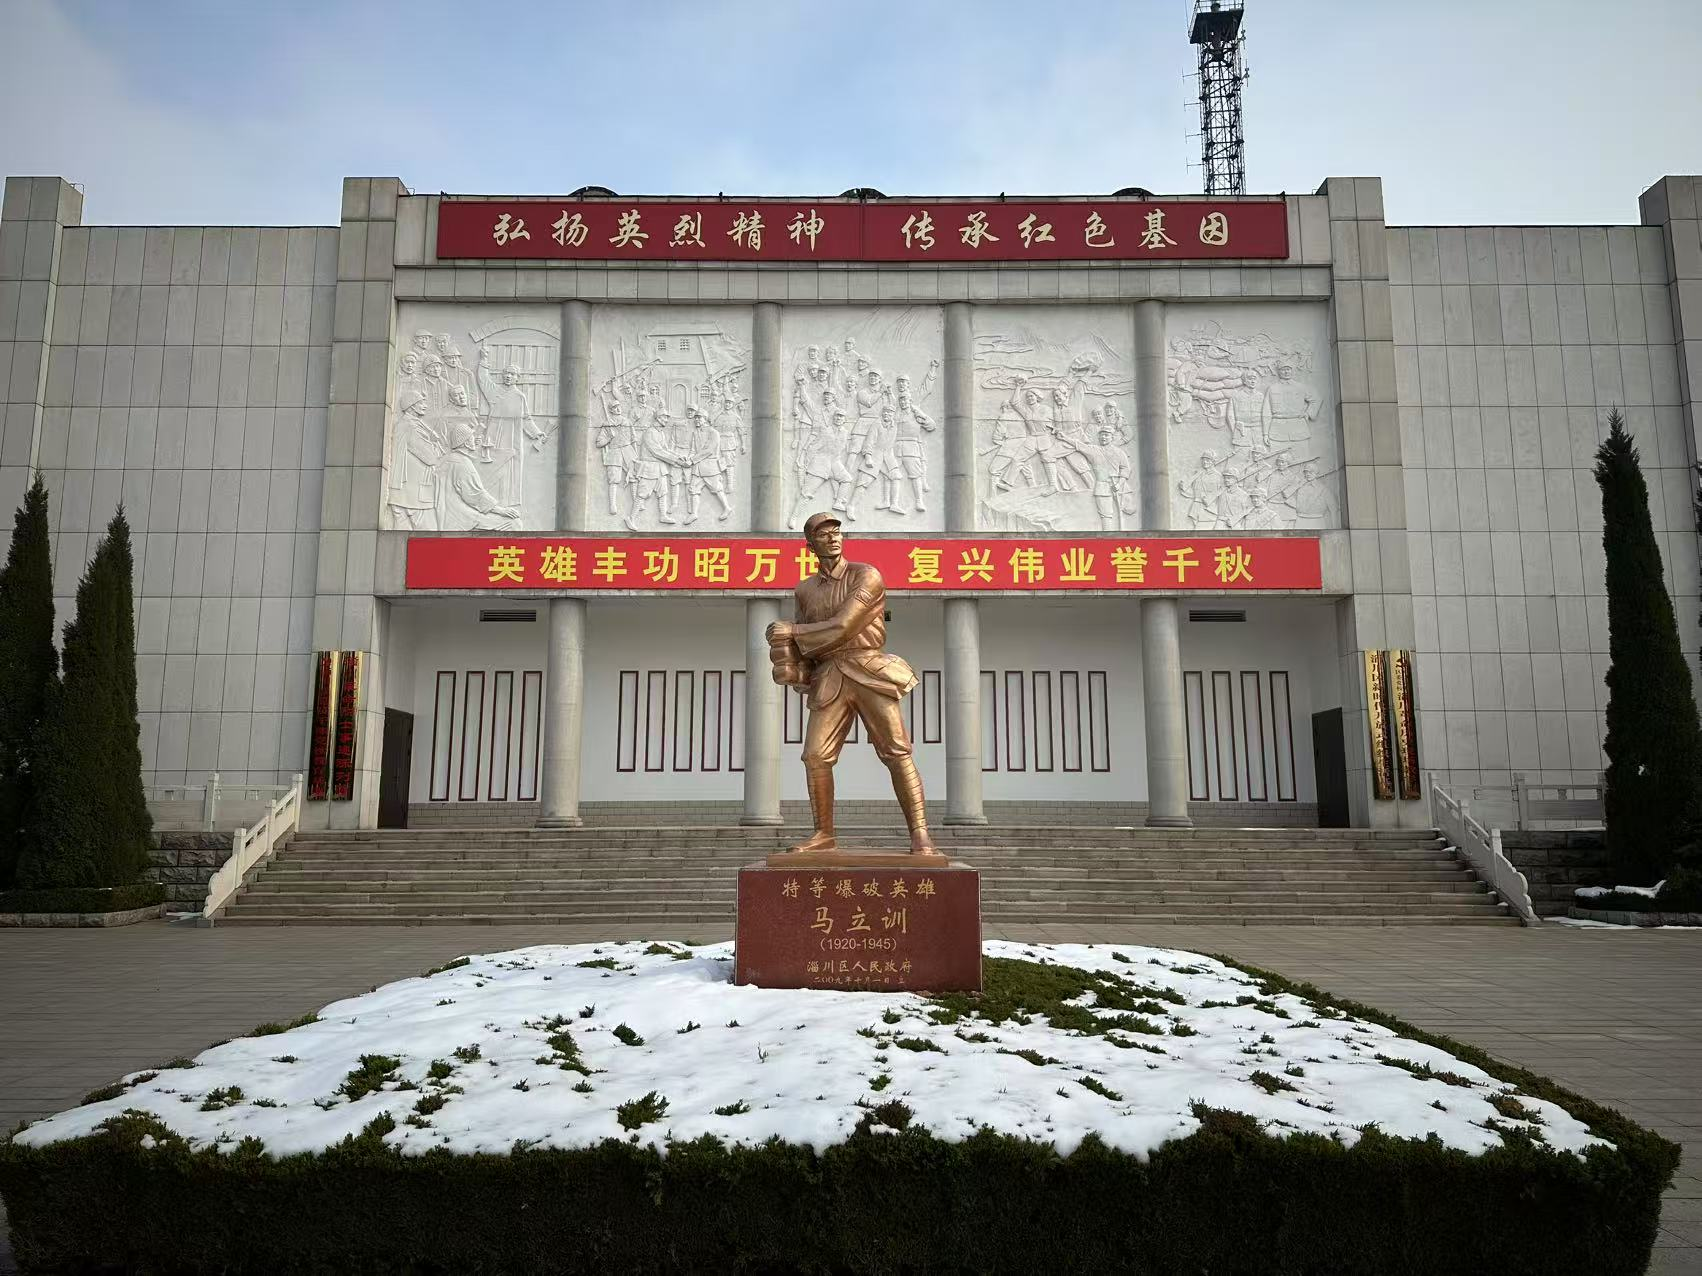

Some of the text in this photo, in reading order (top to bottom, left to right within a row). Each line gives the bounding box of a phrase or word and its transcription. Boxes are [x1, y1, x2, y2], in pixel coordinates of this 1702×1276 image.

[493, 208, 1229, 252] 弘扬英烈精神 传承红色基因
[907, 545, 1254, 583] 复兴伟业誉千秋
[782, 877, 936, 900] 特等爆破英雄
[811, 906, 907, 934] 马立训
[806, 958, 913, 975] 淄川区人民政府
